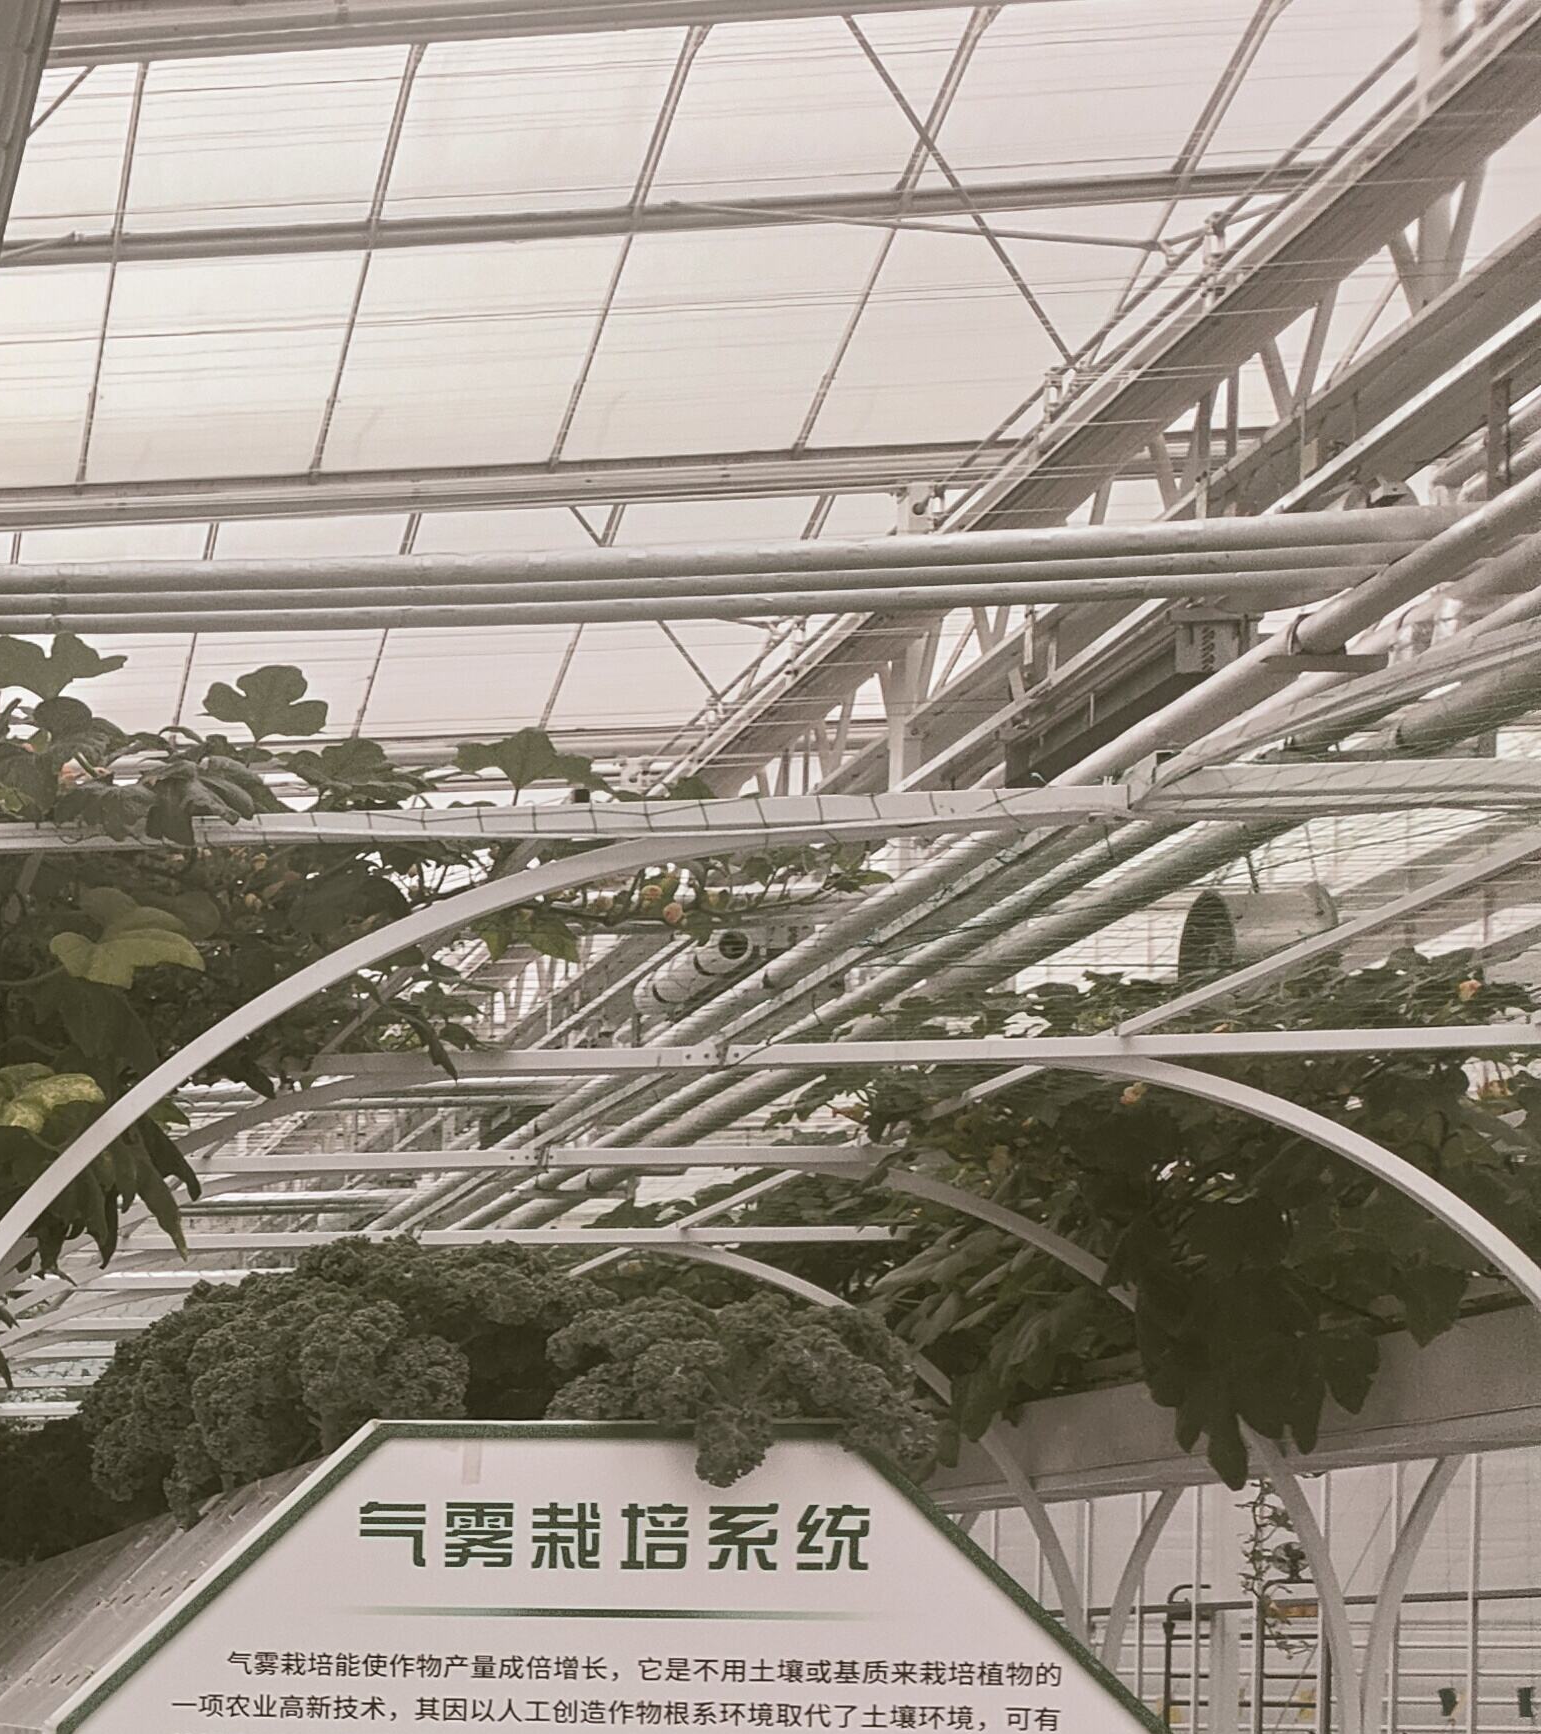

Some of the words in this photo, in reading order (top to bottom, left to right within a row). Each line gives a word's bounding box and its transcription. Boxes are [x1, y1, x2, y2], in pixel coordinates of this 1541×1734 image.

[359, 1501, 870, 1571] 气雾栽培系统
[226, 1651, 1062, 1688] 气雾栽培能使作物产量成倍增长，它是不用土壤或基质来栽培植物的
[171, 1694, 1061, 1732] 一项农业高新技术，其因以人工创造作物根系环境取代了土壤环境，可有
